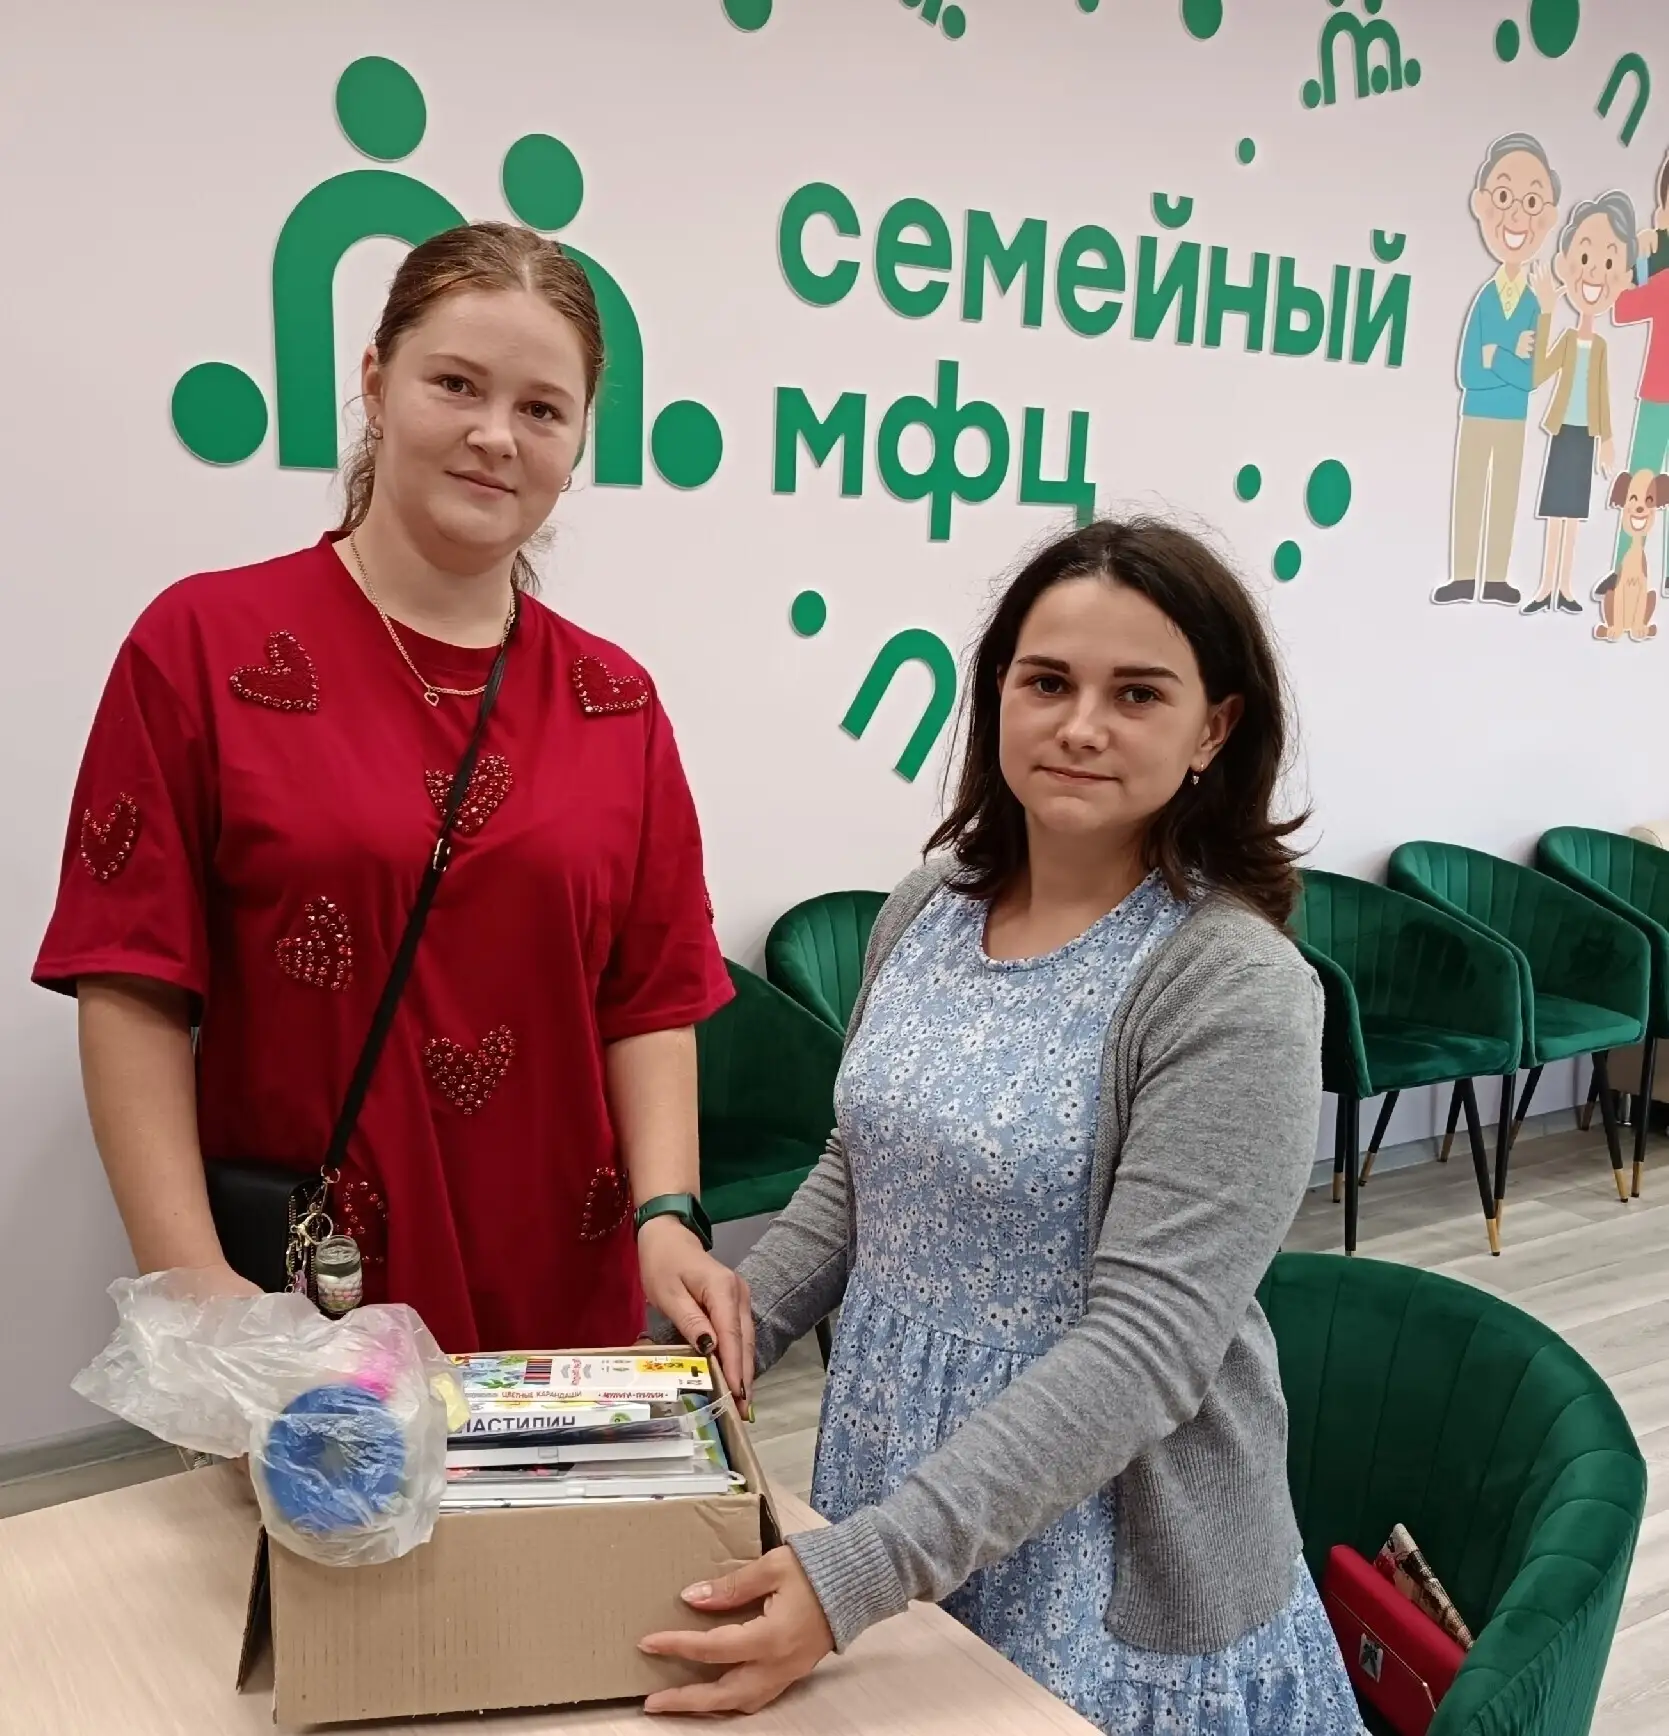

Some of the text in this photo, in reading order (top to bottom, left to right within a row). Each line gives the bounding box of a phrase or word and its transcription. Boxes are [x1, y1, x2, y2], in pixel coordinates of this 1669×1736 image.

[778, 182, 1412, 367] семейный
[773, 359, 1097, 541] мфц
[501, 1391, 534, 1399] ЦВЕТНЫЕ
[536, 1391, 582, 1399] КАРАНДАШИ
